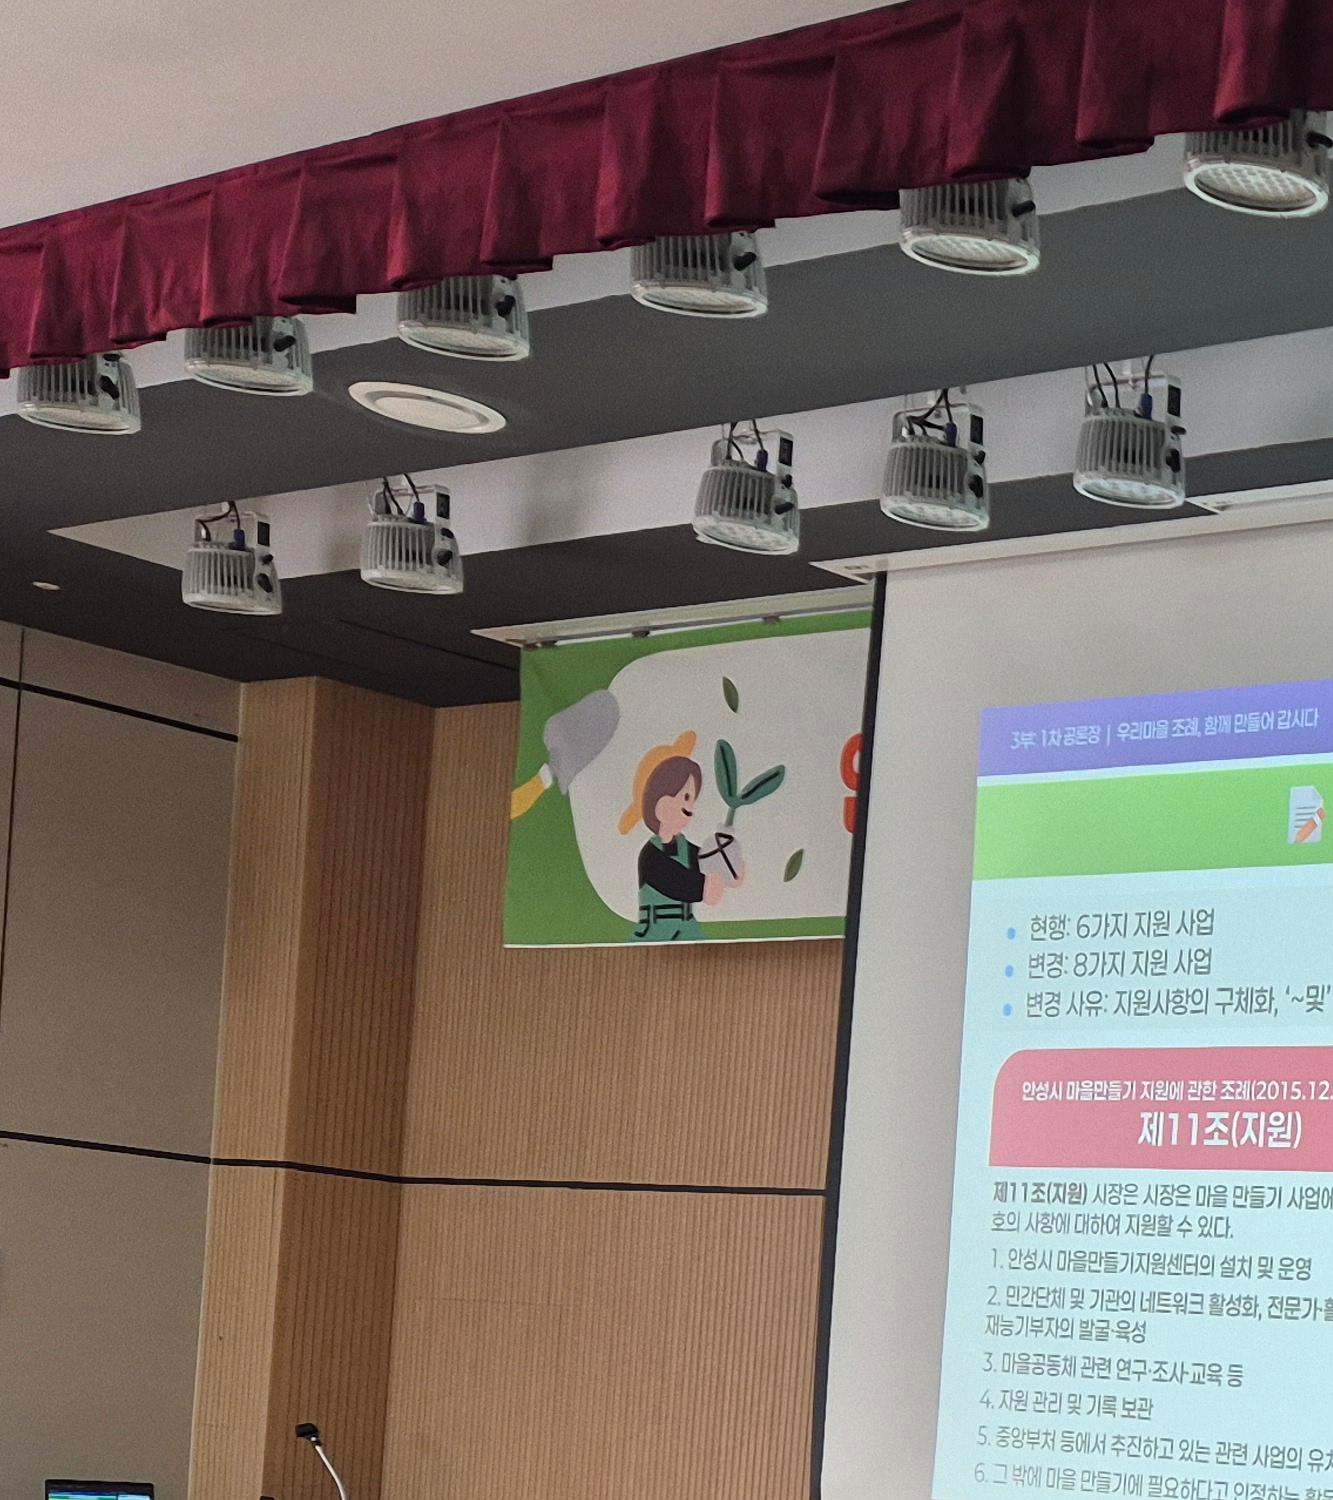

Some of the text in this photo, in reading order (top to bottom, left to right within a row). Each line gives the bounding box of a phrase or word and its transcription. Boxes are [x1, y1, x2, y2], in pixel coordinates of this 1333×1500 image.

[1041, 728, 1062, 747] 1차
[1063, 725, 1101, 746] 공론장
[1116, 719, 1168, 742] 우리마을
[1233, 709, 1274, 733] 만들어
[1277, 707, 1319, 730] 갑시다
[1030, 908, 1214, 941] 현행: 6가지 지원 사업
[1028, 947, 1212, 979] 변경: 8가지 지원 사업
[1026, 991, 1060, 1018] 변경
[1065, 990, 1108, 1017] 사유:
[1113, 987, 1208, 1017] 지원사항의
[1214, 986, 1278, 1018] 구체화,
[1022, 1081, 1062, 1101] 안성시
[1065, 1080, 1136, 1101] 마을만들기
[1139, 1080, 1184, 1101] 지원에
[1187, 1080, 1217, 1101] 관한
[1137, 1110, 1301, 1148] 제11조(지원)
[993, 1181, 1087, 1206] 제11조(지원)
[1092, 1183, 1138, 1206] 시장은
[1142, 1183, 1191, 1207] 시장은
[1195, 1184, 1228, 1208] 마을
[1232, 1185, 1282, 1210] 만들기
[991, 1211, 1233, 1239] 호의 사항에 대하여 지원할 수 있다.
[991, 1247, 1312, 1281] 1. 안성시 마을만들기지원센터의 설치 및 운영
[986, 1285, 1000, 1308] 2.
[1006, 1285, 1065, 1309] 민간단체
[1069, 1288, 1084, 1310] 및
[1089, 1288, 1135, 1313] 기관의
[1139, 1291, 1204, 1315] 네트워크
[1208, 1293, 1261, 1321] 활성화,
[984, 1314, 1074, 1340] 재능기부자의
[980, 1351, 996, 1374] 3.
[1001, 1352, 1076, 1378] 마을공동체
[1080, 1356, 1111, 1380] 관련
[1226, 1364, 1243, 1388] 등
[978, 1388, 1153, 1421] 4. 자원 관리 및 기록 보관
[976, 1425, 991, 1447] 5.
[996, 1426, 1056, 1451] 중앙부처
[1060, 1430, 1106, 1455] 등에서
[1110, 1433, 1173, 1460] 추진하고
[1178, 1439, 1210, 1464] 있는
[1215, 1441, 1247, 1467] 관련
[1251, 1445, 1302, 1471] 사업의
[993, 1463, 1007, 1484] 그
[1012, 1465, 1041, 1487] 밖에
[1045, 1467, 1076, 1491] 마을
[1080, 1470, 1143, 1496] 만들기에
